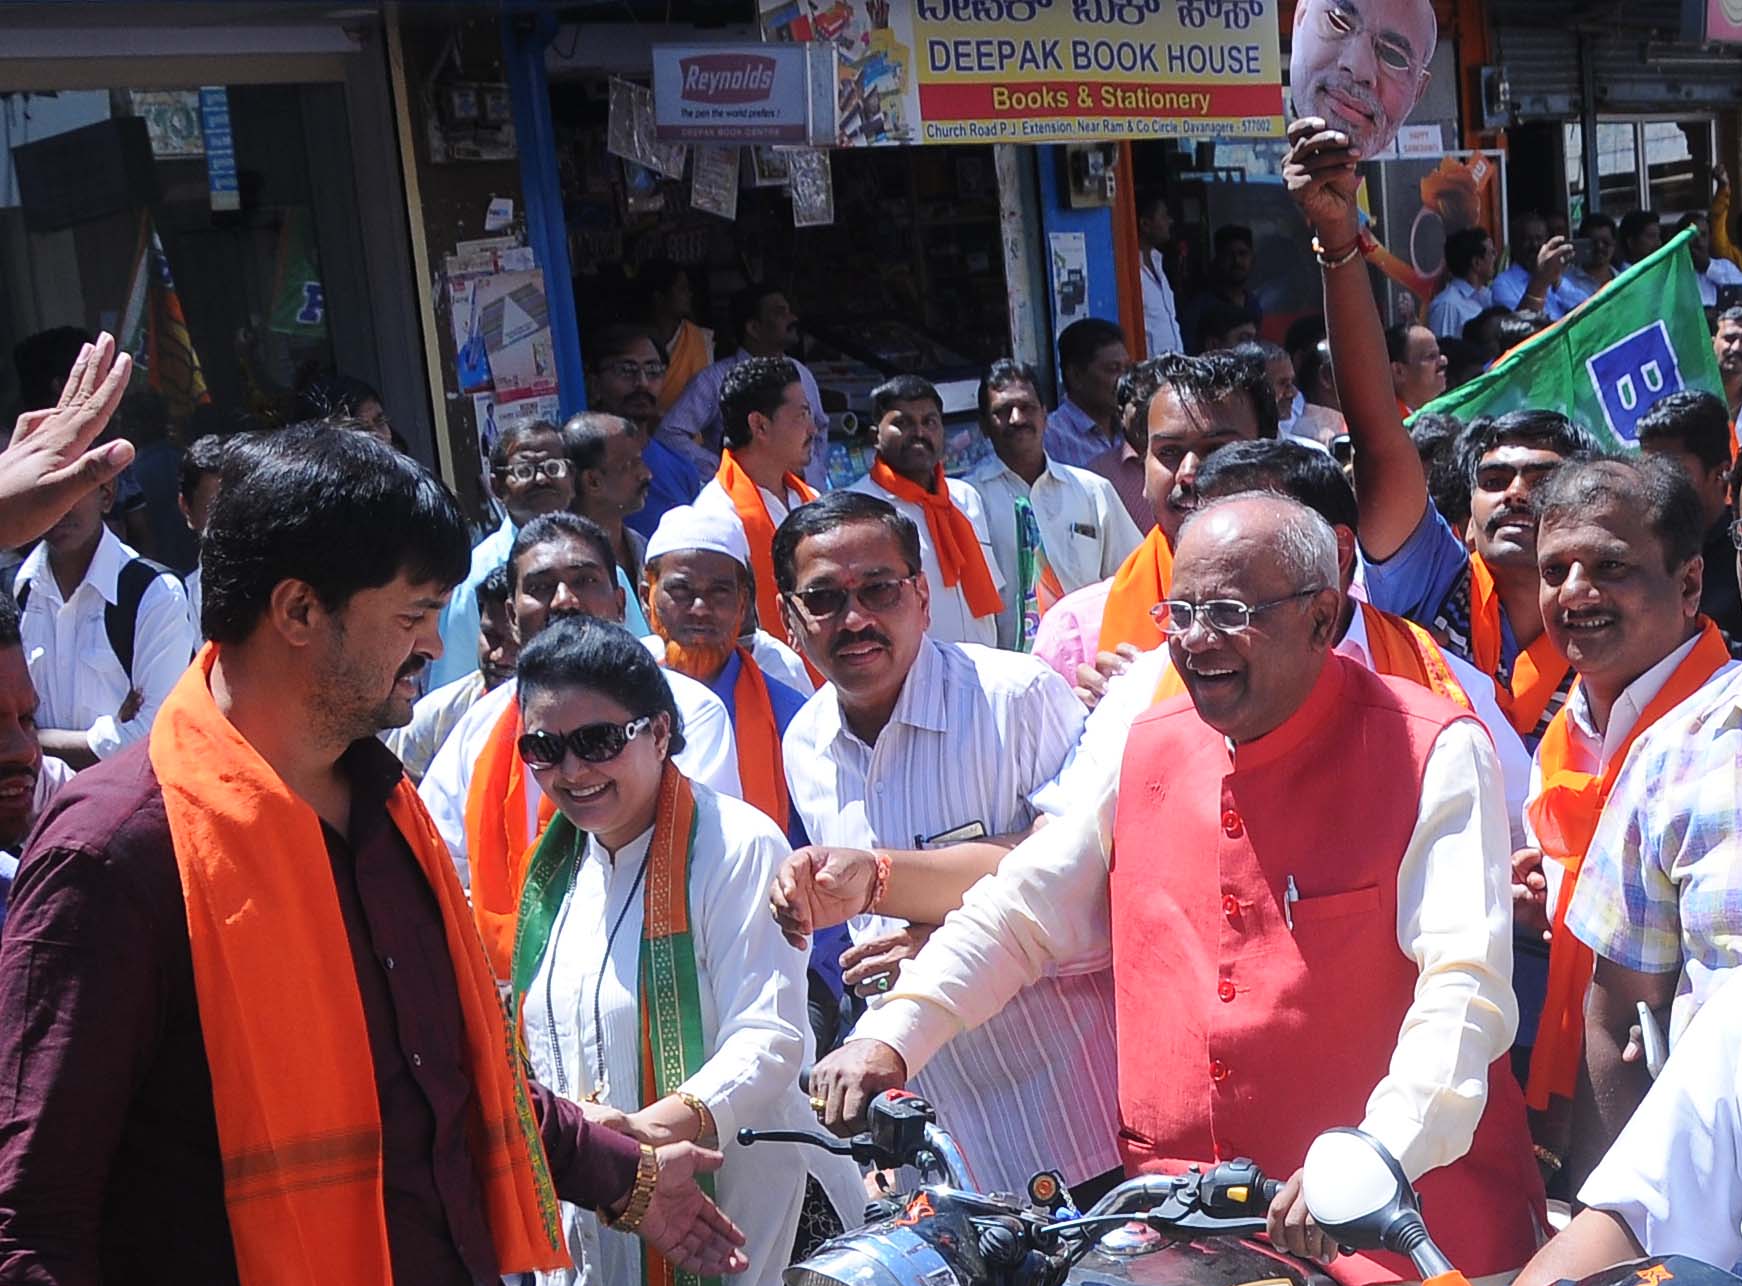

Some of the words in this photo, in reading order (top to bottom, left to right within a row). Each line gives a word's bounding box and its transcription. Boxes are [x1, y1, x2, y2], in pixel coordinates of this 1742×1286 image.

[928, 39, 1064, 72] DEEPAK
[1072, 41, 1159, 73] BOOK
[1168, 44, 1262, 75] HOUSE
[685, 62, 773, 96] Reynolds
[681, 107, 693, 118] The
[695, 109, 710, 119] pen
[712, 108, 724, 118] the
[726, 108, 748, 118] world
[993, 86, 1069, 111] Books
[1077, 86, 1093, 109] &
[1100, 86, 1211, 114] Stationery
[926, 121, 968, 138] Church
[969, 122, 997, 137] Road
[1076, 120, 1100, 135] Near
[1103, 120, 1125, 134] Ram
[1127, 121, 1135, 133] &
[1182, 119, 1236, 135] Davanagere
[1241, 119, 1271, 133] 577002
